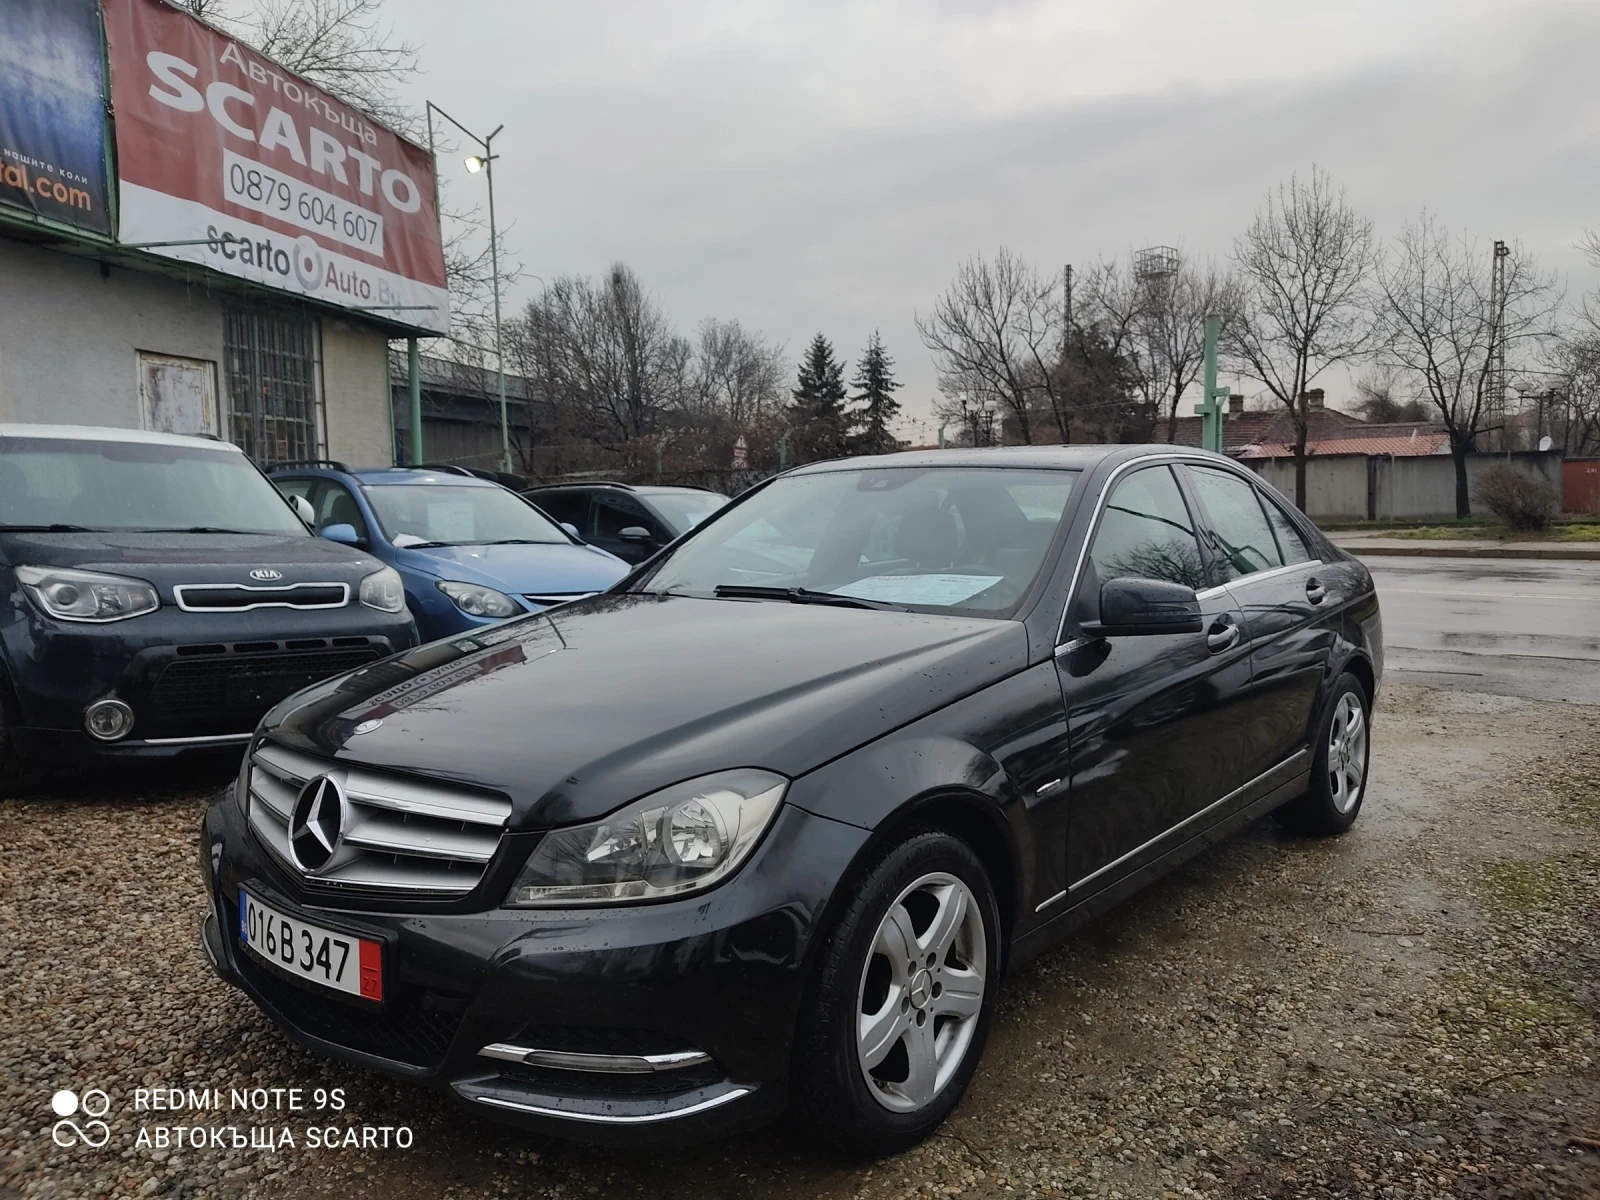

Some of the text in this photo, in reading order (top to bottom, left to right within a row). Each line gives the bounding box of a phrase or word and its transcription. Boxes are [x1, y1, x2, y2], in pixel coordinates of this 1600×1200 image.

[146, 51, 421, 213] SCARTO
[3, 147, 88, 185] нашите коли
[230, 163, 377, 245] 0879 604 607
[207, 224, 290, 276] scarto
[252, 569, 280, 579] KIA
